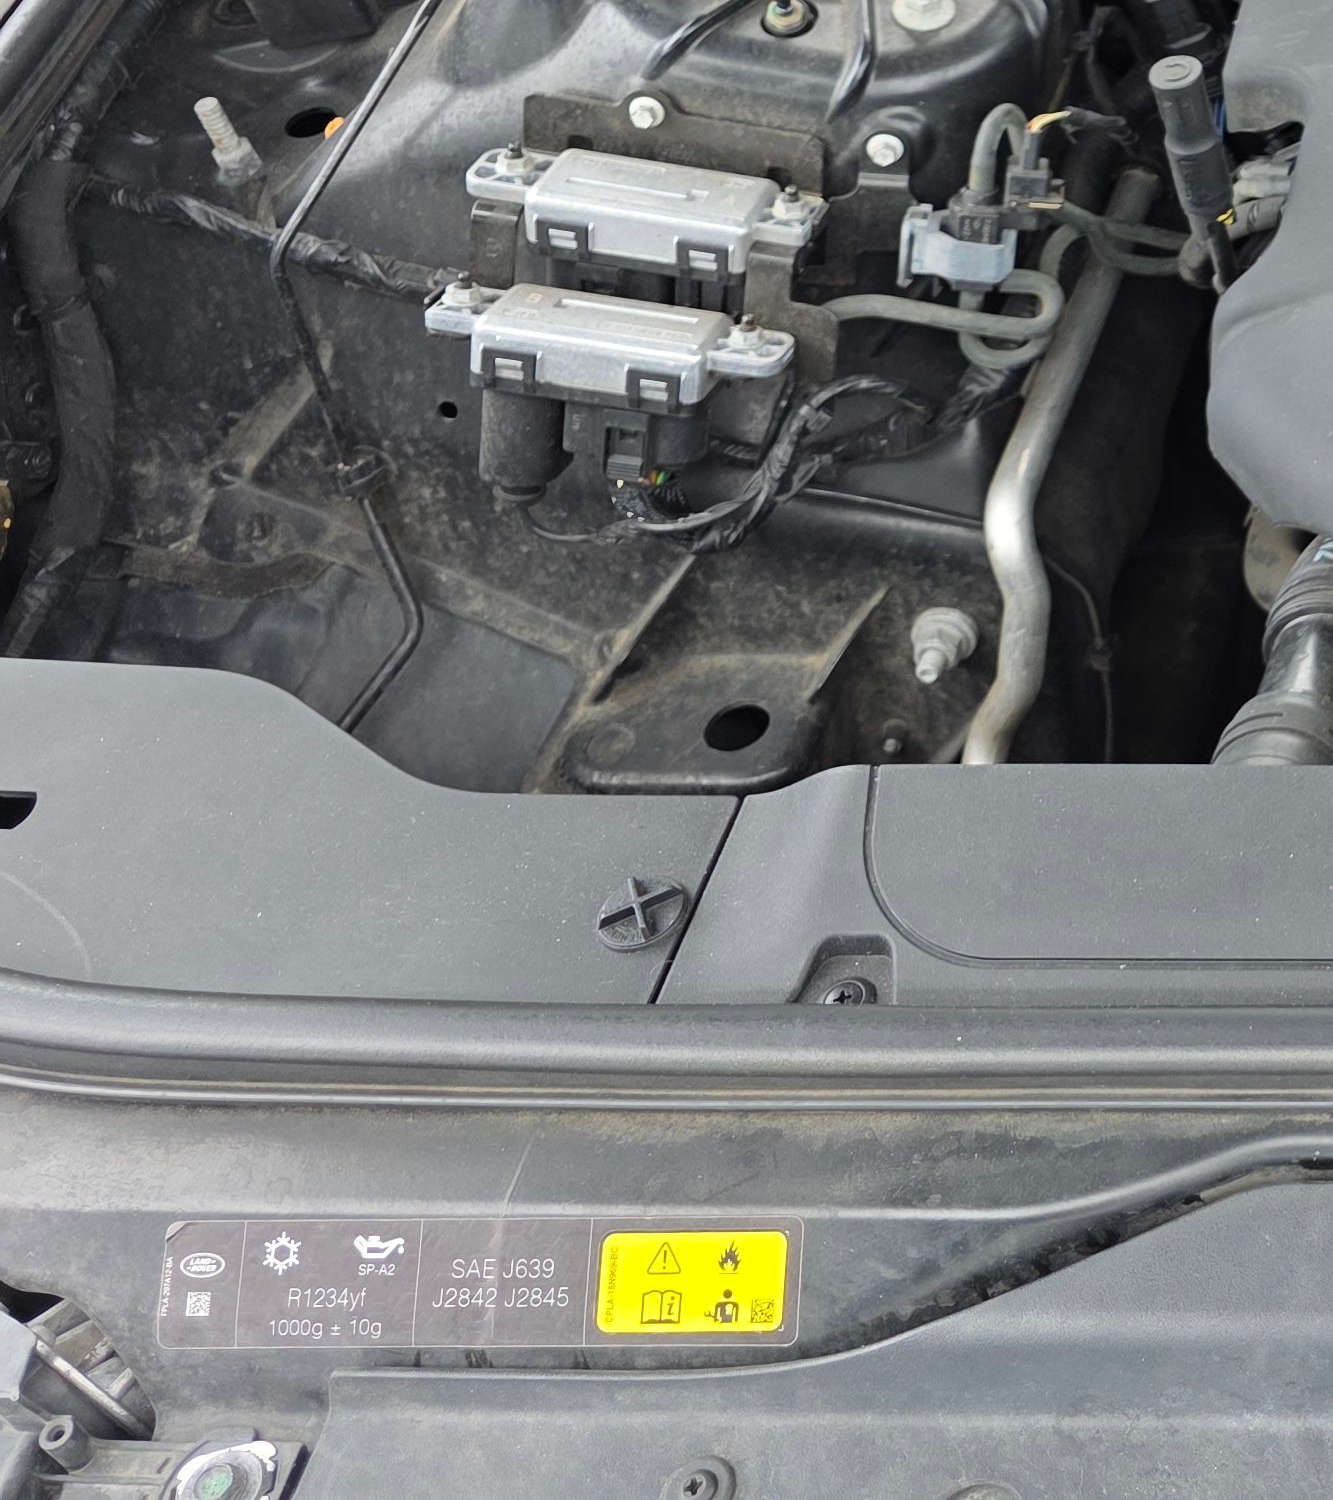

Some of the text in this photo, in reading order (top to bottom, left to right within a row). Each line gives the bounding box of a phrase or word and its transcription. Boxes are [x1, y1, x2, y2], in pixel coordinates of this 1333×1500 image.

[358, 1264, 396, 1276] SP-A2
[451, 1258, 555, 1279] SAE J639
[287, 1287, 367, 1312] R1234yf
[432, 1287, 569, 1308] J2842 J2845
[269, 1319, 323, 1340] 1000g
[350, 1318, 382, 1340] 10g
